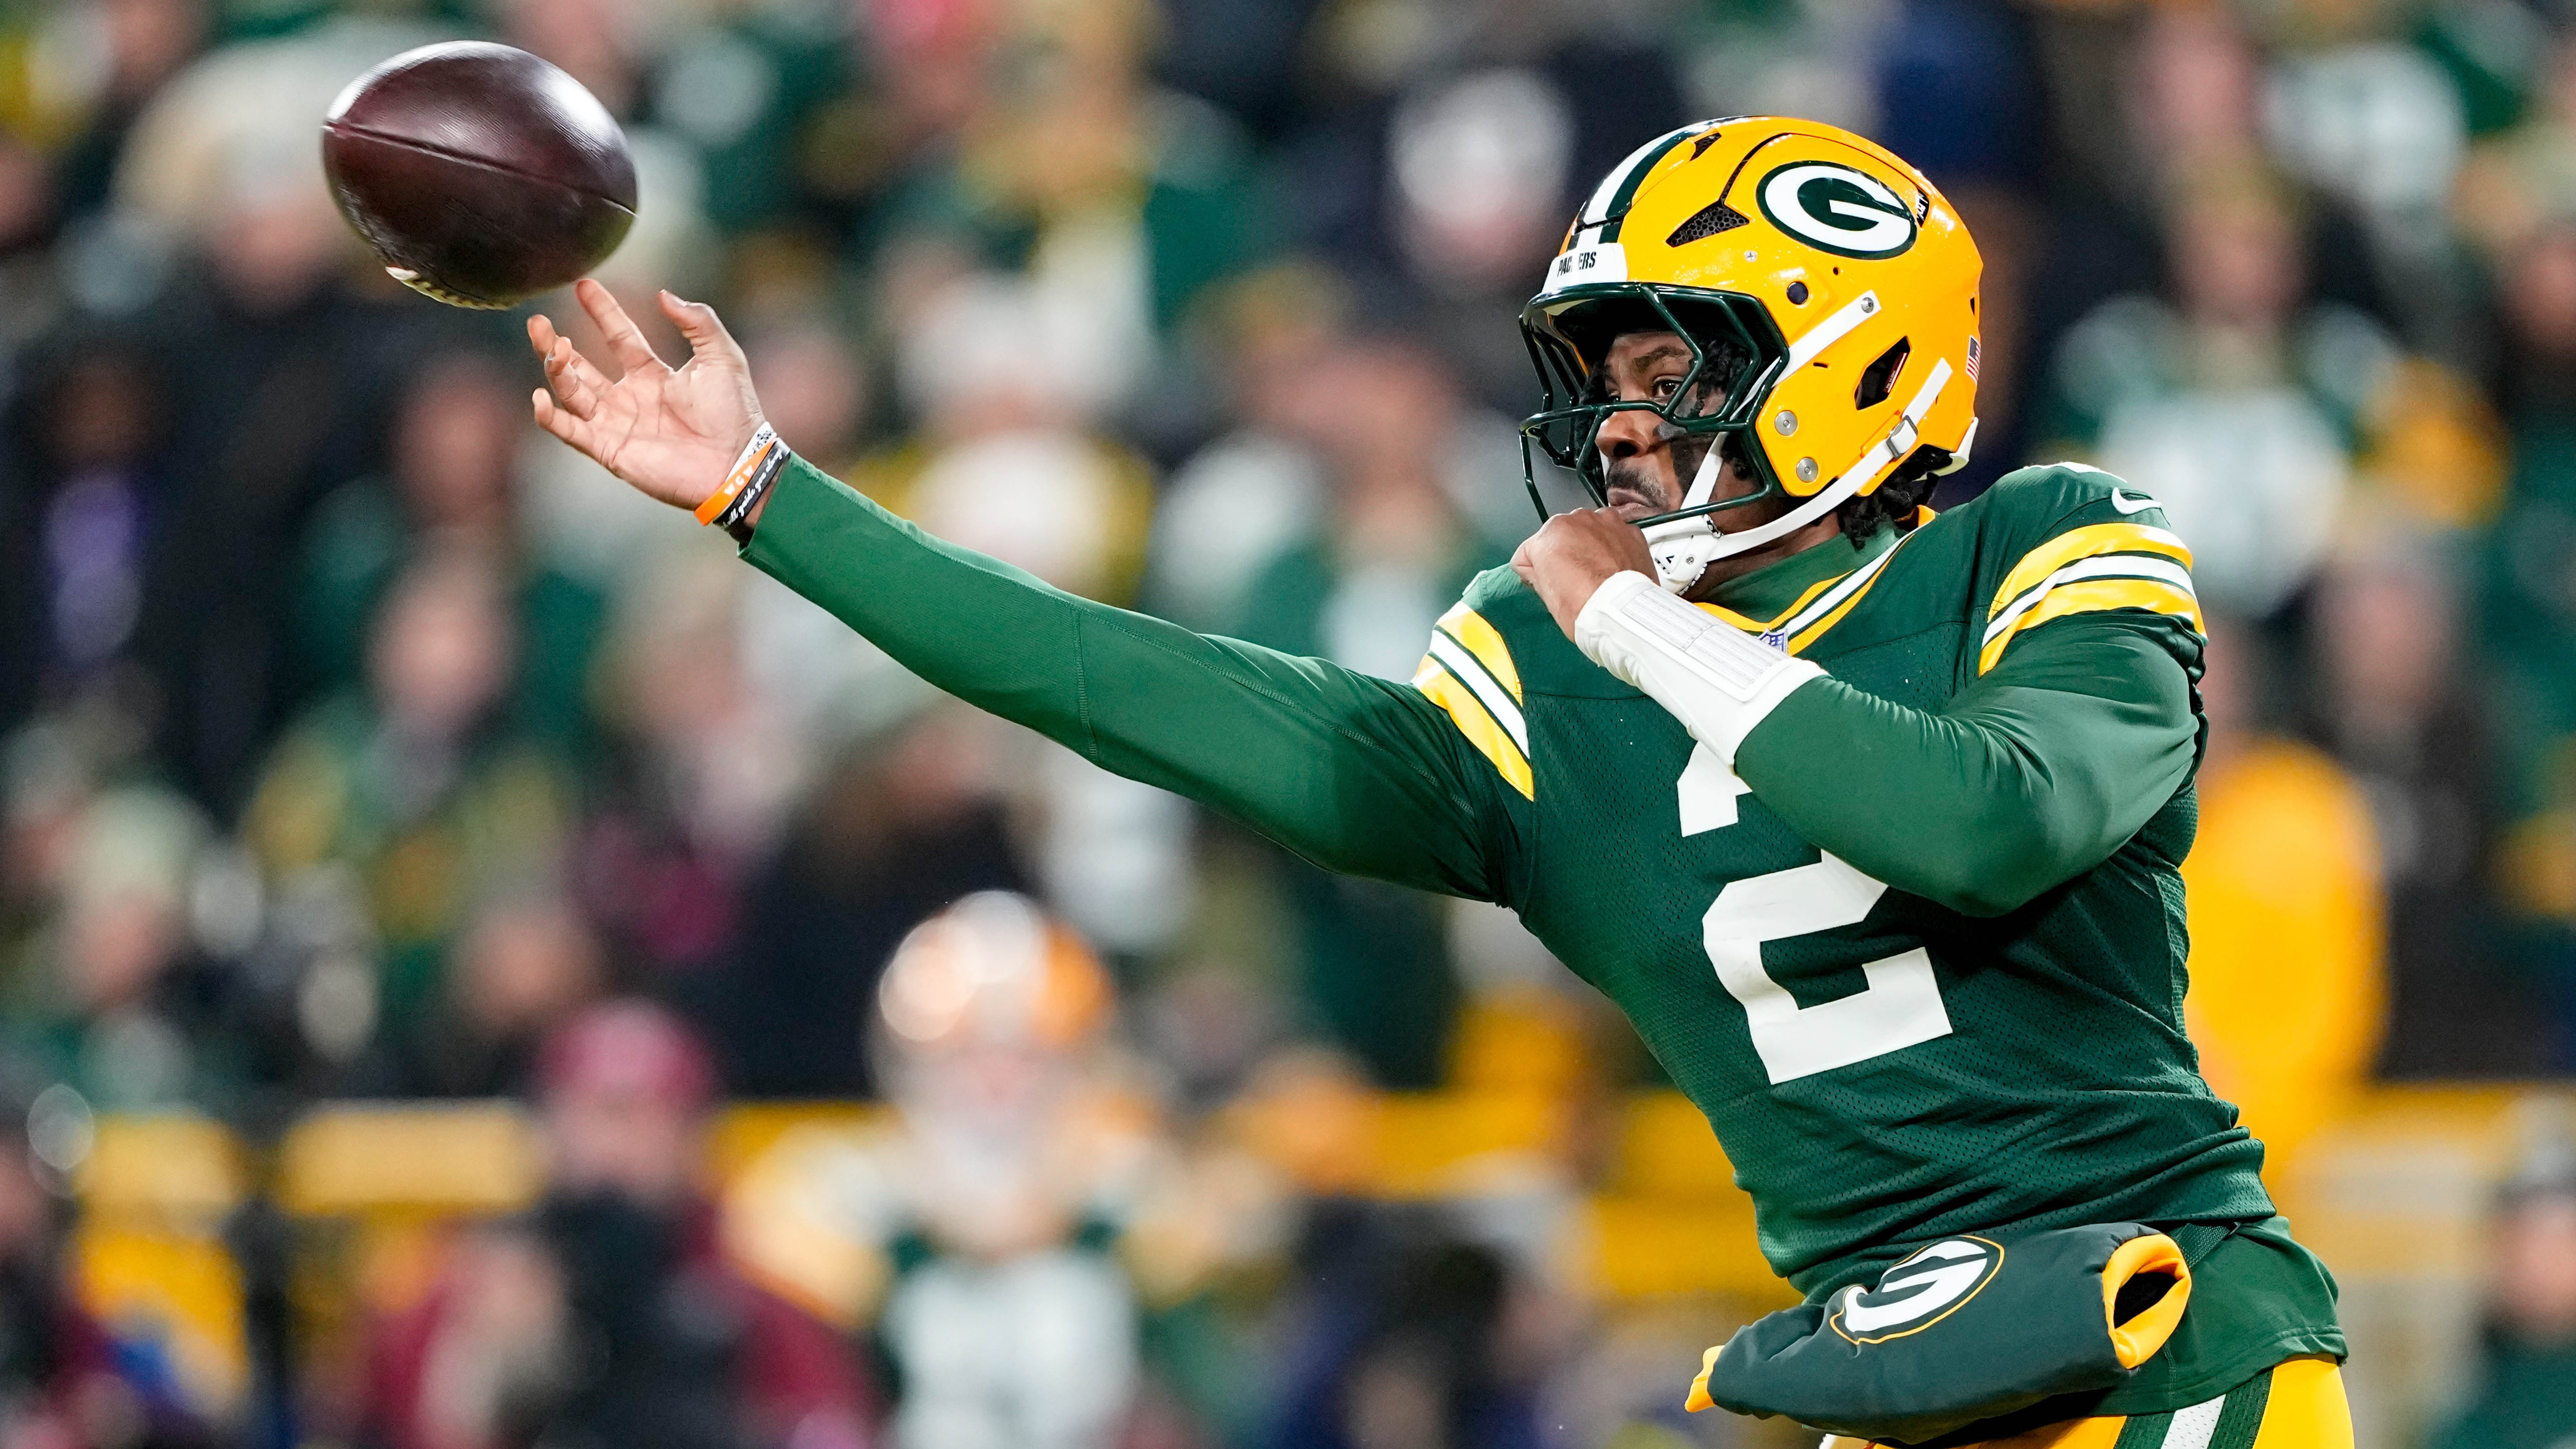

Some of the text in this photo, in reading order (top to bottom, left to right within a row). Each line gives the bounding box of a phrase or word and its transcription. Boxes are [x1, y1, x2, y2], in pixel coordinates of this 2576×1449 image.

[1765, 166, 1911, 251] G
[1557, 252, 1596, 277] PACERS
[755, 472, 766, 492] you
[1677, 741, 1953, 1085] 2
[1845, 1241, 1987, 1332] G
